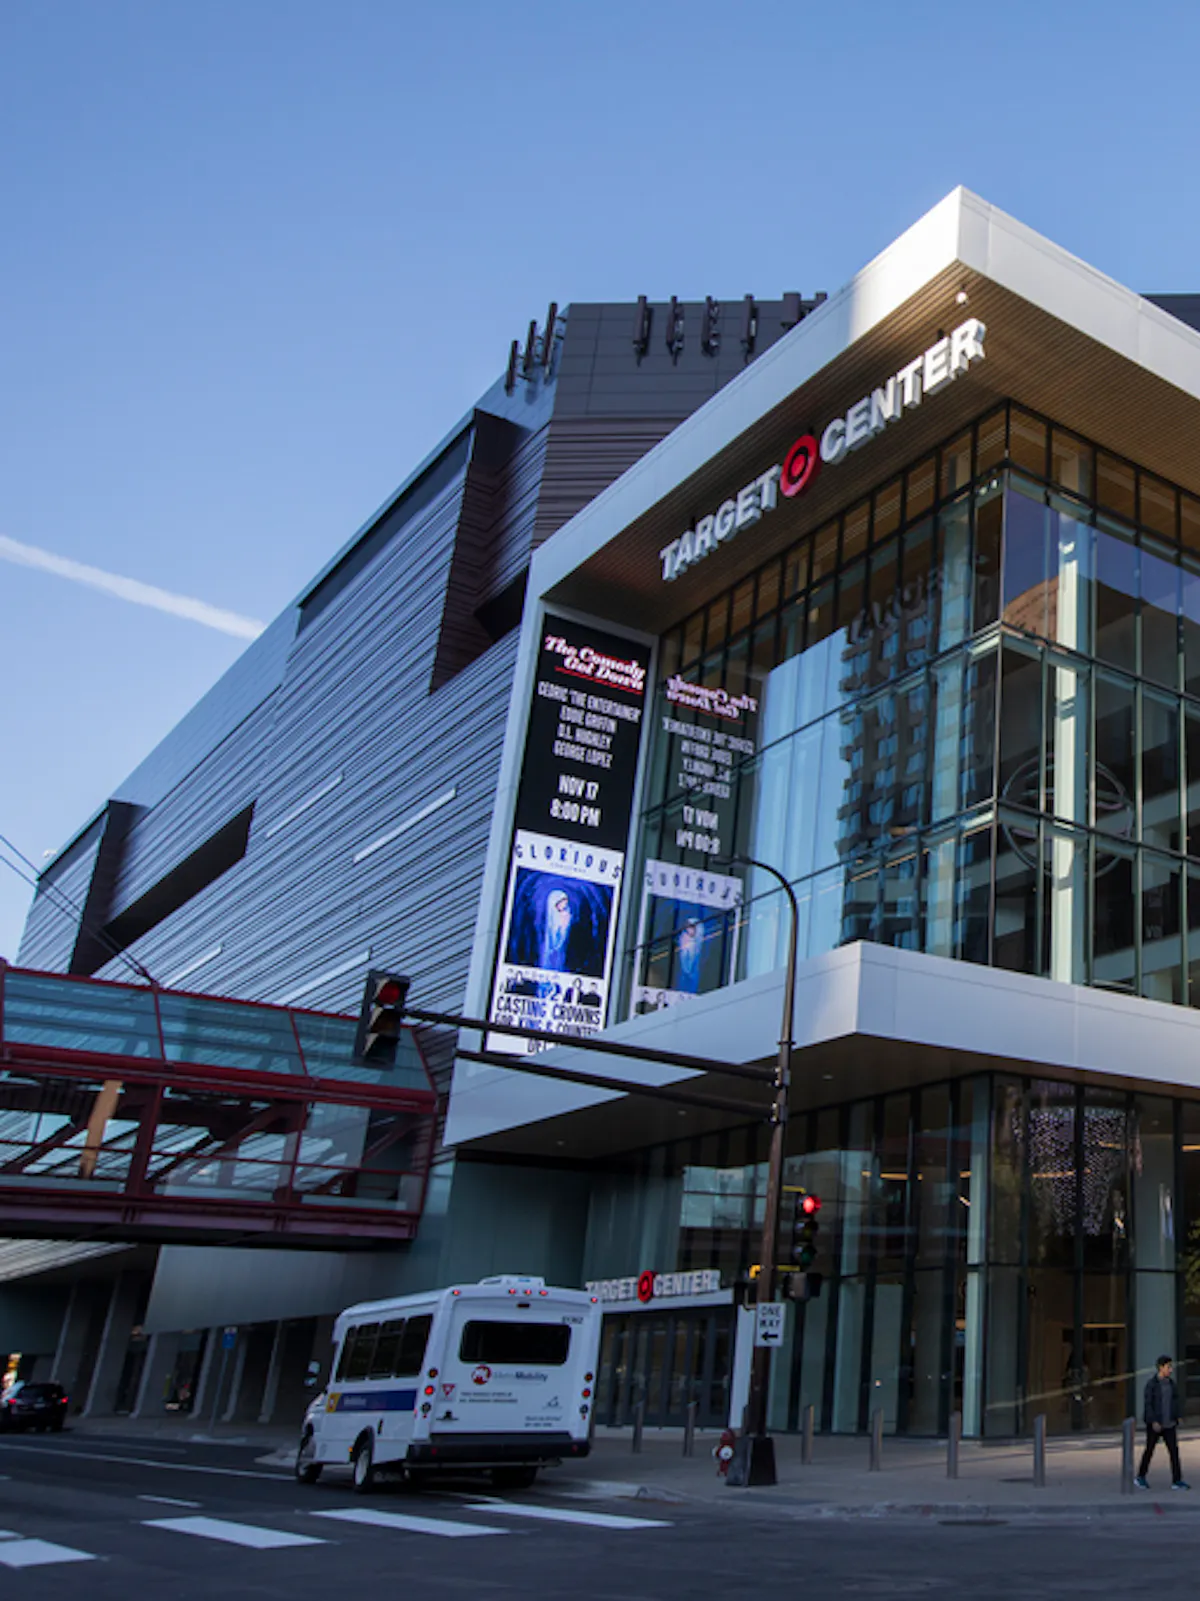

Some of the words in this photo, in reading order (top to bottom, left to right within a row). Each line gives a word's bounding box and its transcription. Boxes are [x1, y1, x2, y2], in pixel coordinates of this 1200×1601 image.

[660, 463, 782, 581] TARGET
[820, 317, 987, 465] CENTER
[544, 634, 578, 657] The
[579, 646, 645, 681] Comedy
[563, 656, 596, 675] Got
[595, 666, 644, 690] Down
[553, 740, 585, 763] GEORGE
[559, 774, 586, 798] NOV
[586, 781, 600, 801] 17
[550, 798, 580, 822] 8:00
[580, 804, 601, 827] PM
[514, 844, 623, 879] GLORIOUS
[497, 996, 547, 1018] CASTING
[552, 1003, 602, 1025] CROWNS
[585, 1277, 638, 1302] TARGET
[653, 1269, 720, 1296] CENTER
[760, 1318, 780, 1329] WAY
[761, 1305, 781, 1317] ONE
